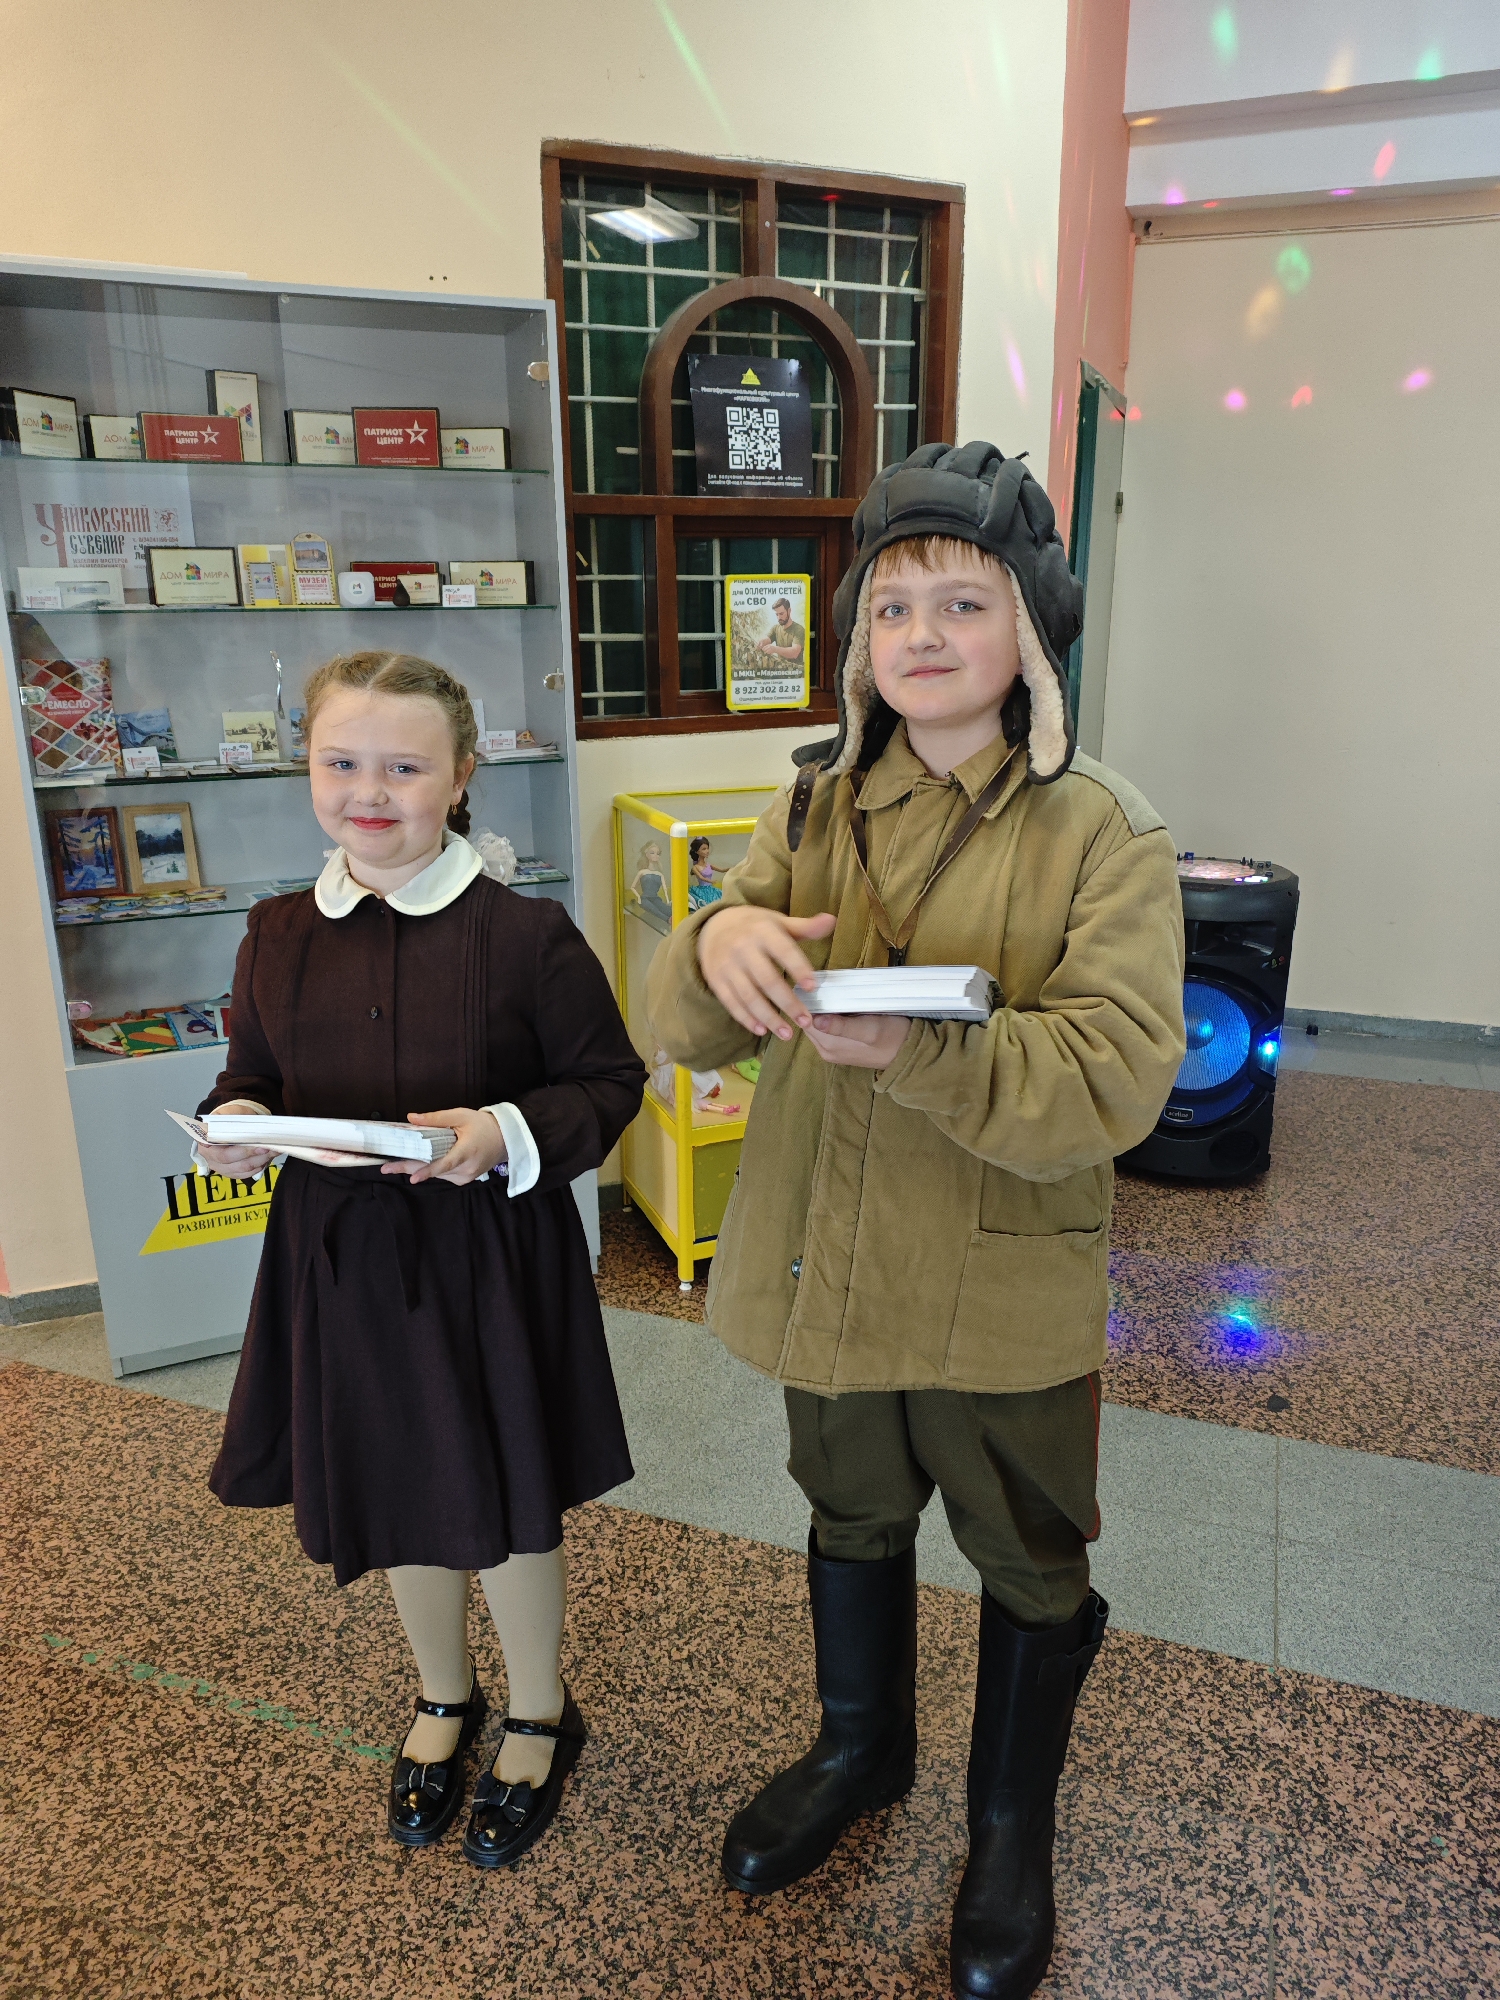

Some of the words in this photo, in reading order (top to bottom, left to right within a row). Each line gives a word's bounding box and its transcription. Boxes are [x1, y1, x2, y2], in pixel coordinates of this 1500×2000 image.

[22, 417, 40, 428] ДОМ
[54, 422, 74, 432] МИРА
[363, 427, 402, 436] ПАТРИОТ
[103, 434, 128, 442] ДОМ
[301, 434, 322, 442] ДОМ
[376, 436, 404, 446] ЦЕНТР
[159, 572, 182, 580] ДОМ
[778, 585, 802, 594] СЕТЕЙ
[746, 597, 768, 606] СВО
[742, 686, 758, 694] 922
[41, 699, 92, 710] РЕМЕСЛО
[160, 1163, 280, 1222] ЦЕНТ
[177, 1214, 241, 1234] РАЗВИТИЯ
[244, 1208, 270, 1223] КУЛ
